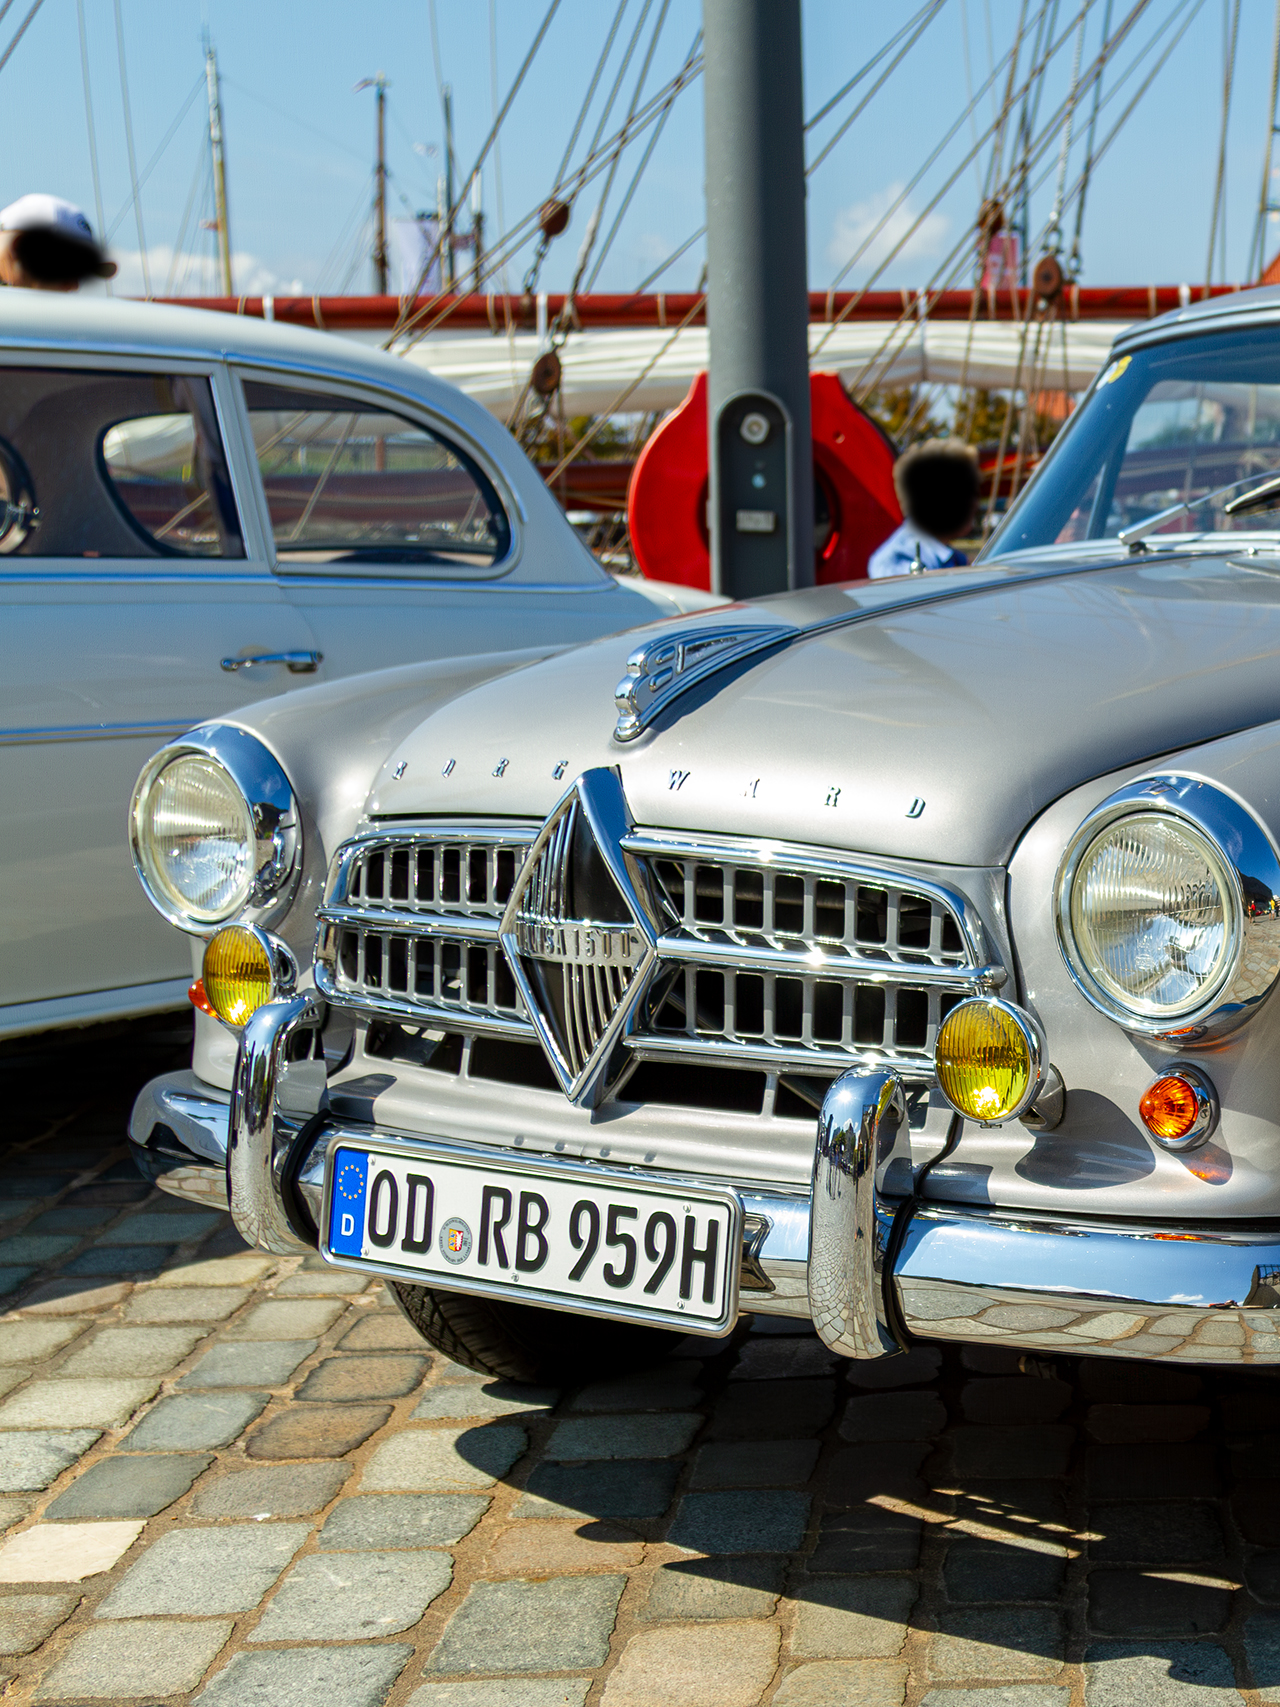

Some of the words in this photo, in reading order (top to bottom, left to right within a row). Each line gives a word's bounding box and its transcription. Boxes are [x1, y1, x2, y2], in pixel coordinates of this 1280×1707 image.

[573, 927, 631, 959] 1500
[340, 1213, 355, 1237] D
[368, 1169, 435, 1255] OD
[477, 1184, 550, 1273] RB
[567, 1199, 720, 1305] 959H
